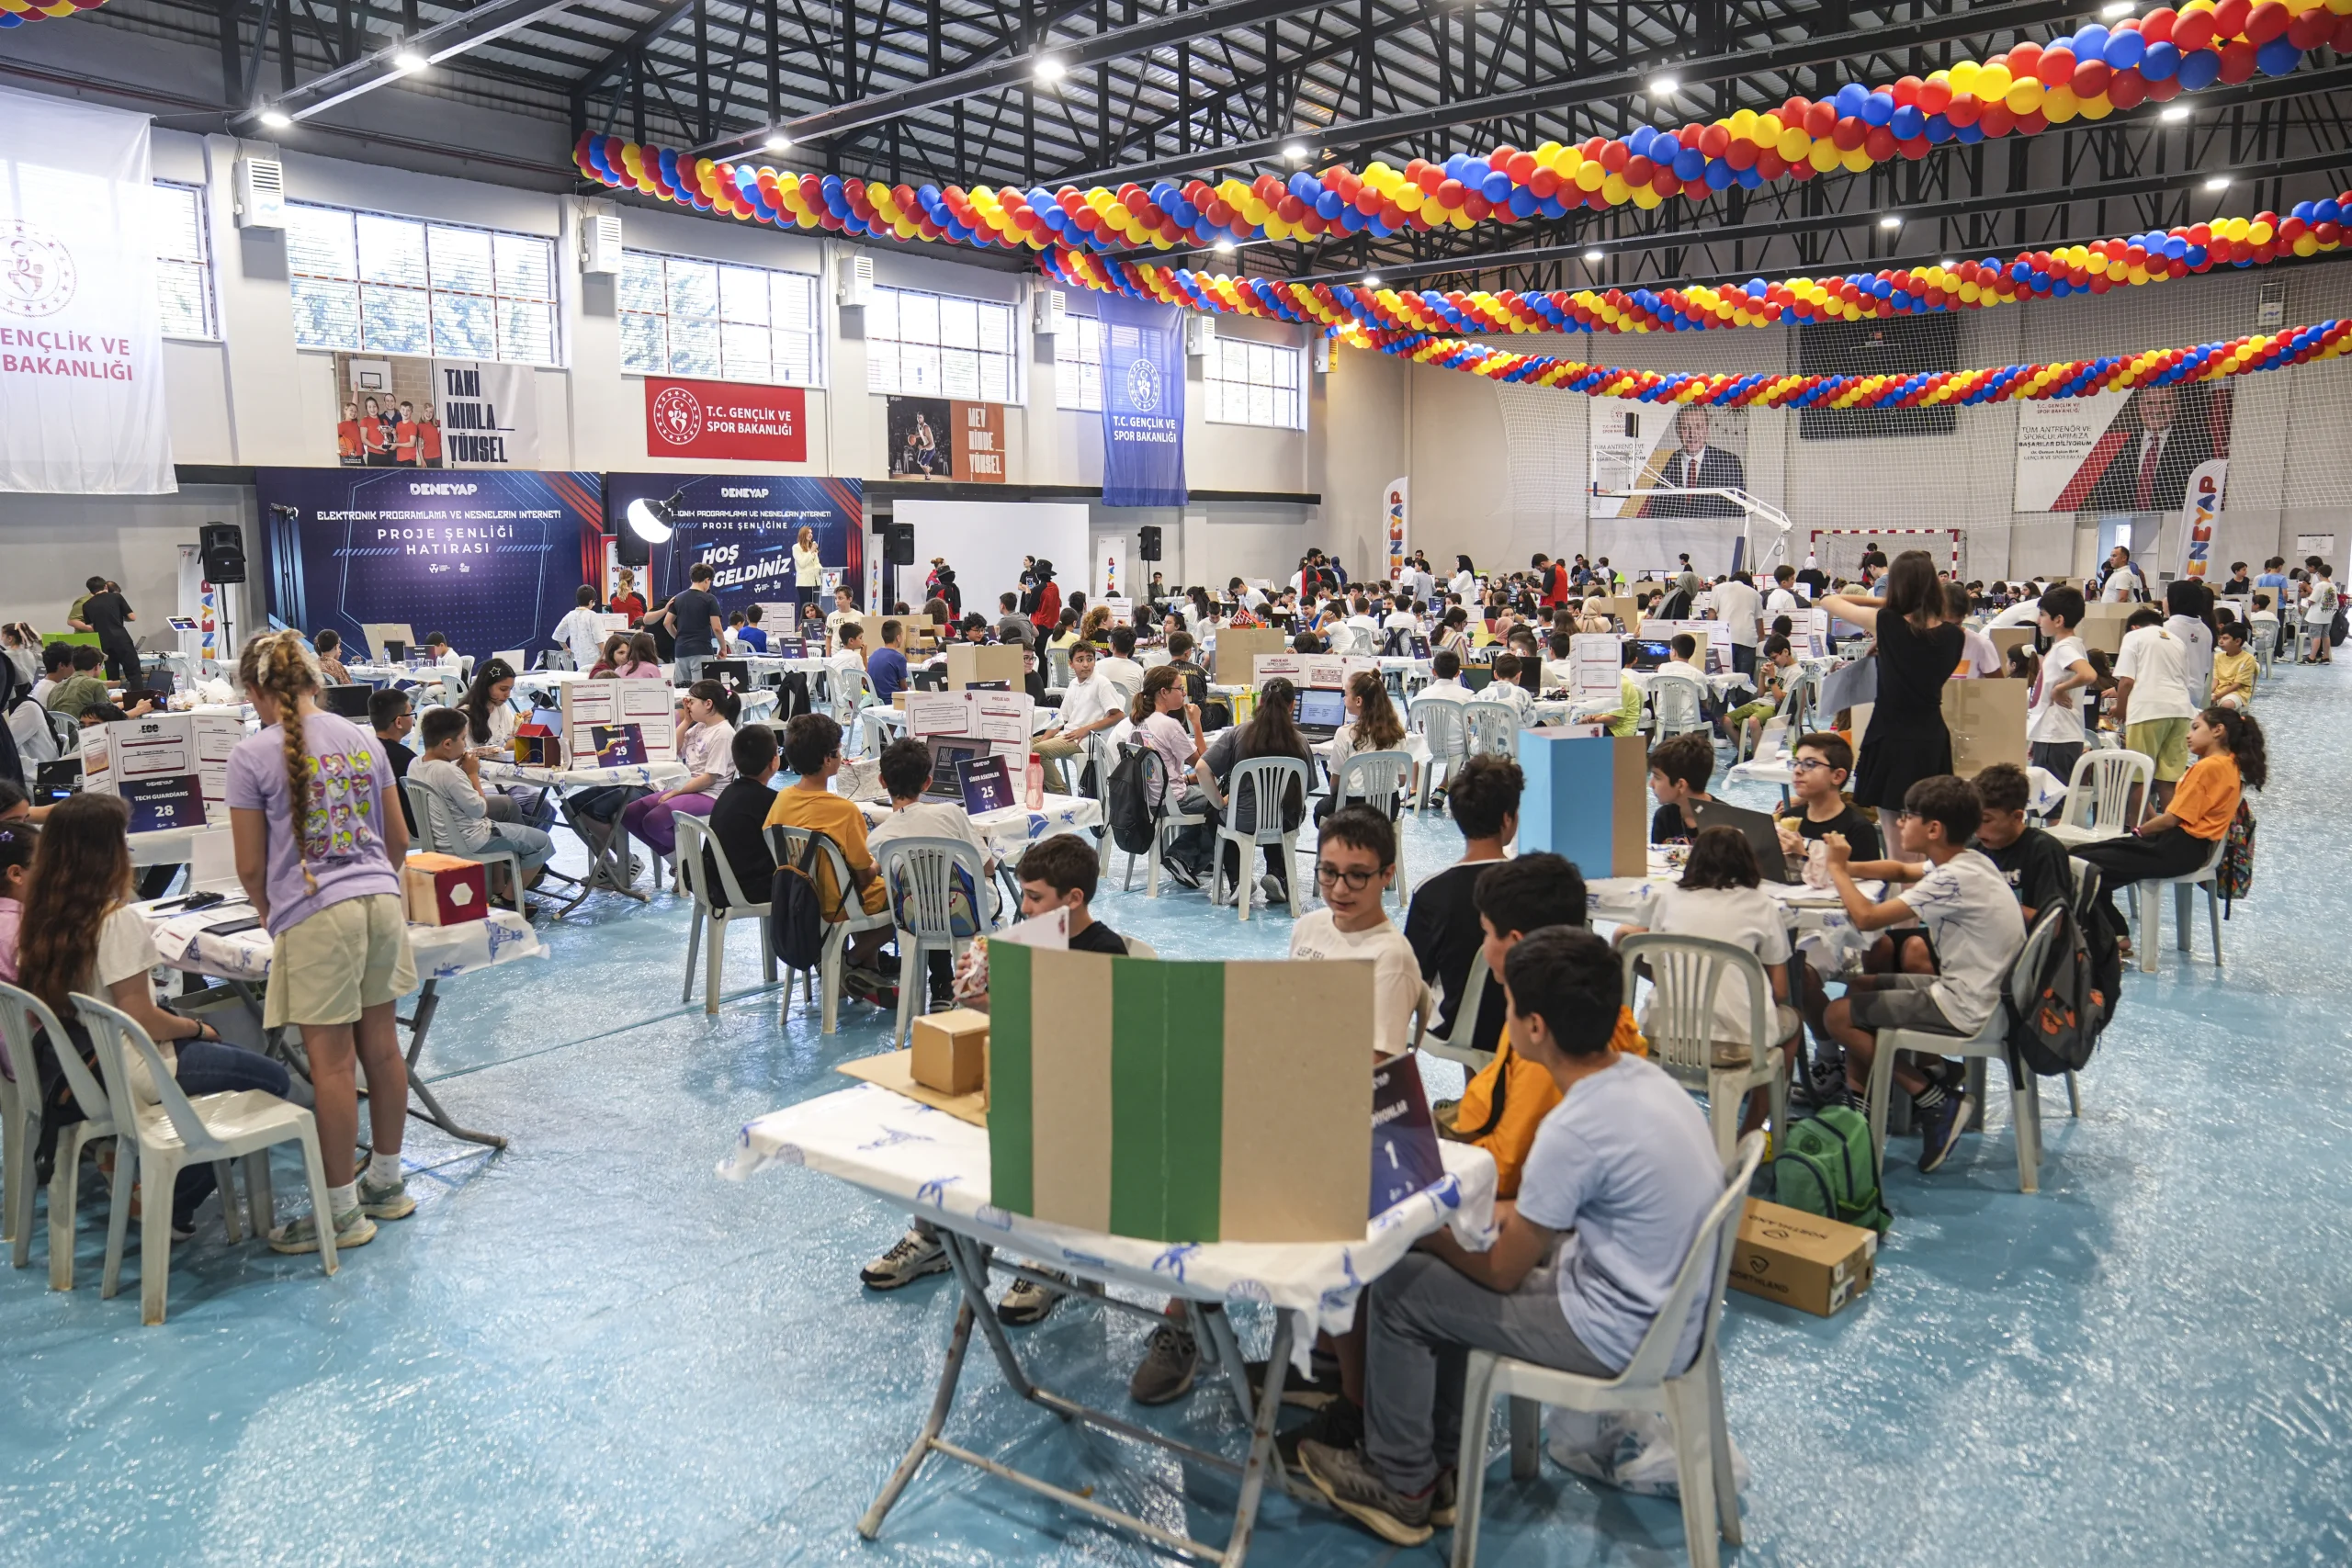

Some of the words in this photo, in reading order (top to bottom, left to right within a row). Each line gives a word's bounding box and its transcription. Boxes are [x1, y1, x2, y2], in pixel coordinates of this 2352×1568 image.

[0, 328, 94, 353] ENÇLİK
[101, 337, 130, 356] VE
[2, 354, 133, 381] BAKANLIĞI
[707, 405, 727, 418] T.C.
[729, 407, 775, 423] GENÇLİK
[778, 411, 792, 422] VE
[707, 421, 735, 434] SPOR
[738, 423, 793, 436] BAKANLIĞI
[1113, 415, 1128, 427] T.C.
[1130, 416, 1164, 431] GENÇLİK
[1166, 419, 1176, 430] VE
[1114, 430, 1136, 442] SPOR
[1136, 431, 1177, 444] BAKANLIĞI
[447, 433, 508, 464] YÜKSEL
[410, 483, 478, 496] DENEYAP
[720, 487, 770, 499] DENEYAP
[379, 511, 447, 520] PROGRAMLAMA
[449, 510, 462, 519] VE
[378, 527, 436, 540] PROJE
[445, 525, 514, 541] ŞENLİĞİ
[702, 522, 733, 530] PROJE
[737, 520, 788, 532] ŞENLİĞİNE
[2186, 475, 2217, 581] ENEYAP
[1389, 491, 1403, 581] DENEYAP
[406, 543, 491, 556] HATIRASI
[702, 544, 740, 568] HOŞ
[713, 554, 793, 589] GELDİNİZ
[200, 579, 216, 660] ENEYAP
[615, 746, 628, 756] 29
[980, 785, 994, 798] 25
[154, 805, 175, 818] 28
[1385, 1140, 1399, 1170] 1
